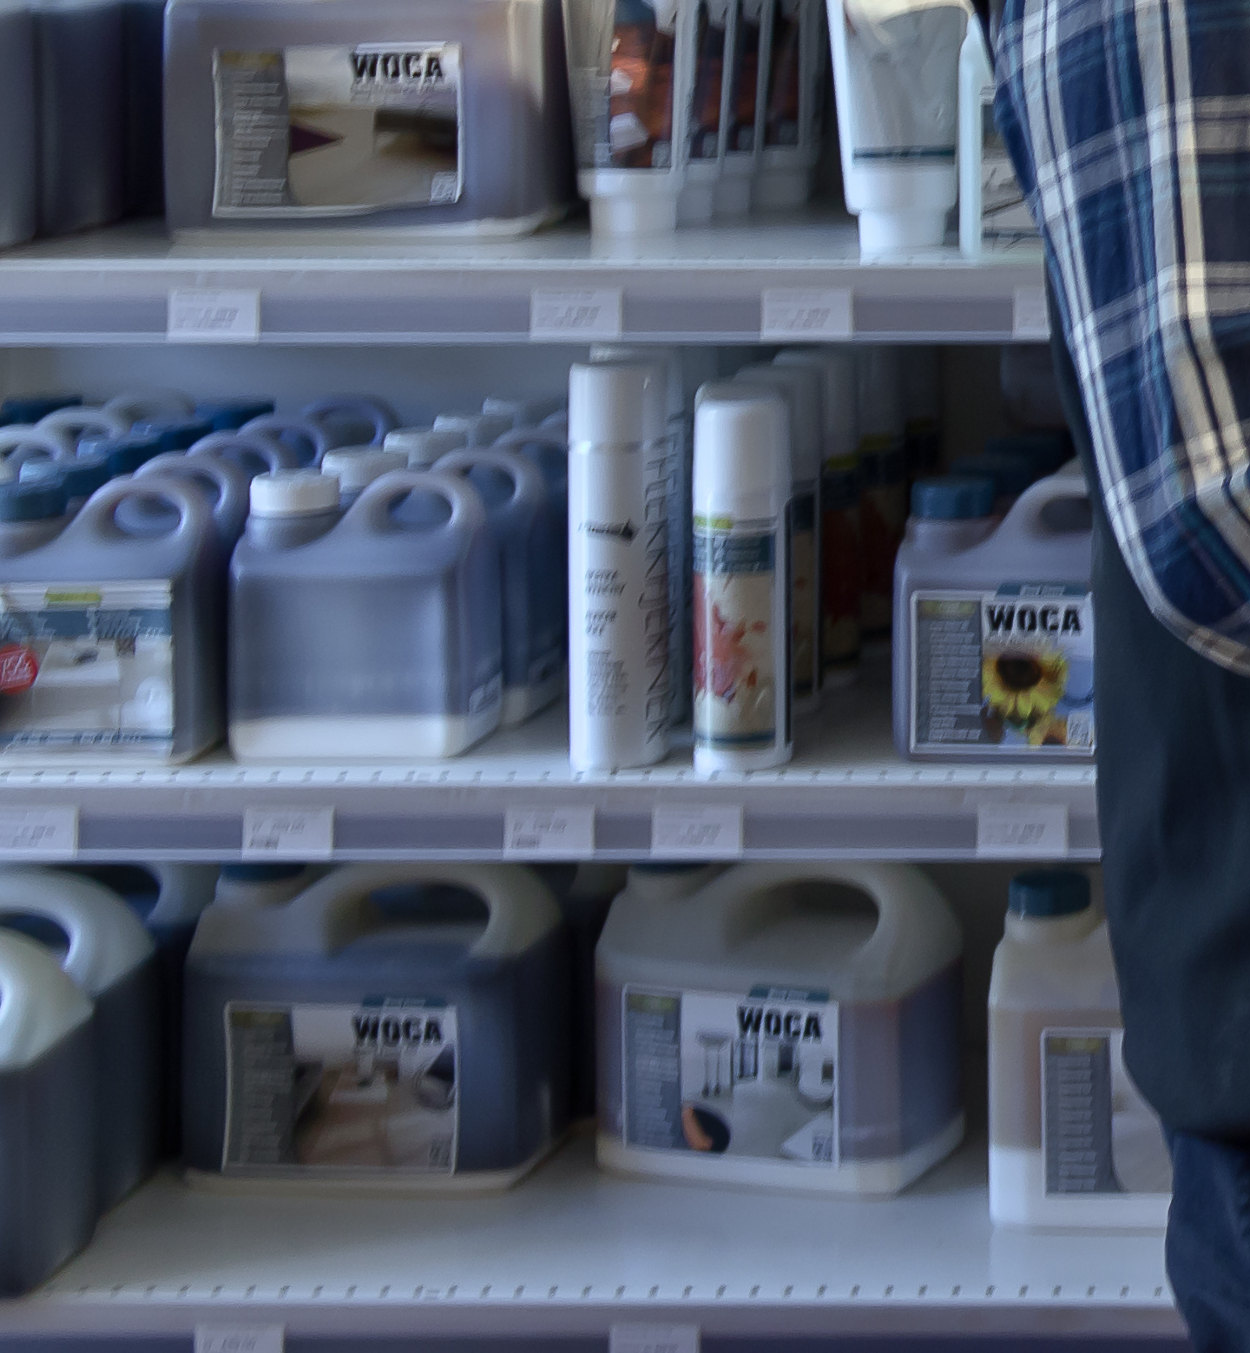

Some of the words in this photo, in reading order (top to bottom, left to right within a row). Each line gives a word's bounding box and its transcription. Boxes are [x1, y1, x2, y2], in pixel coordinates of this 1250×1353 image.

[351, 51, 443, 79] WOCA
[987, 604, 1081, 631] WOCA
[353, 1015, 442, 1043] WOCA
[738, 1006, 822, 1038] WOCA
